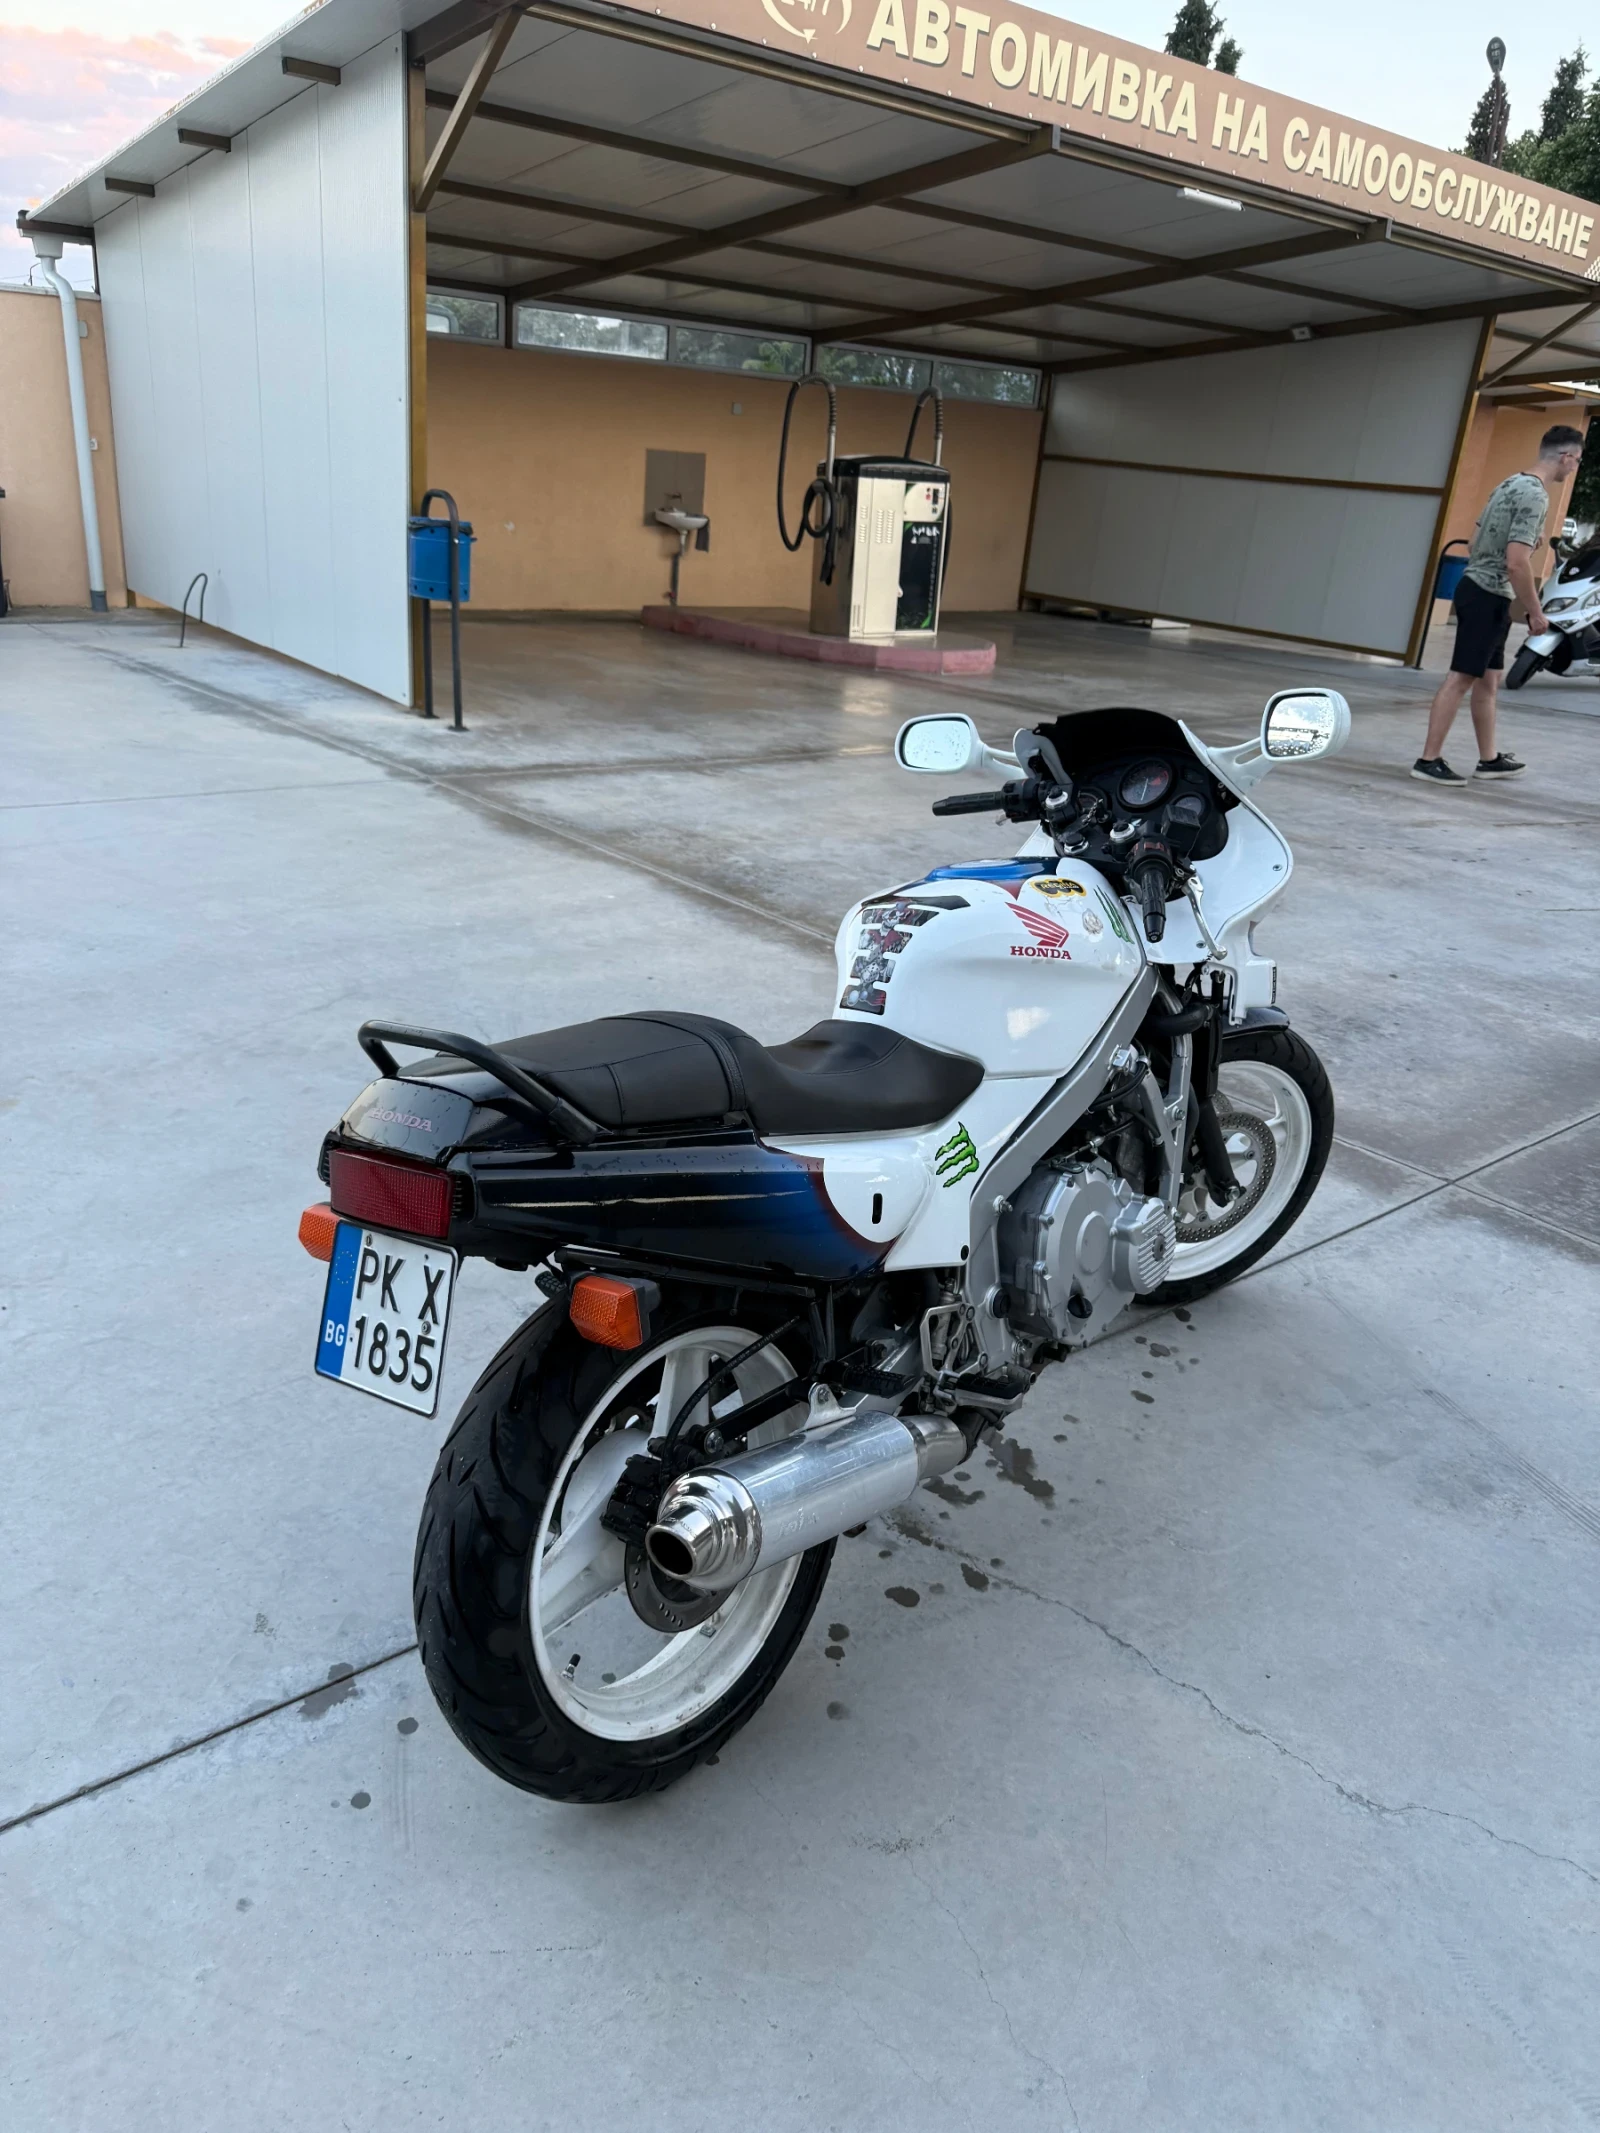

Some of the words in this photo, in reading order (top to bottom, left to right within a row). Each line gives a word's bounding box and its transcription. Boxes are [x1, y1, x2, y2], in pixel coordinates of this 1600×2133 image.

[866, 0, 1198, 142] АВТОМИВКА
[1211, 92, 1269, 162] НА
[1283, 116, 1595, 259] САМООБСЛУЖВАНЕ
[1010, 945, 1072, 960] HONDA
[369, 1107, 433, 1132] HONDA
[356, 1247, 406, 1313] PK
[418, 1264, 446, 1325] X
[324, 1319, 345, 1347] BG
[354, 1314, 436, 1392] 1835
